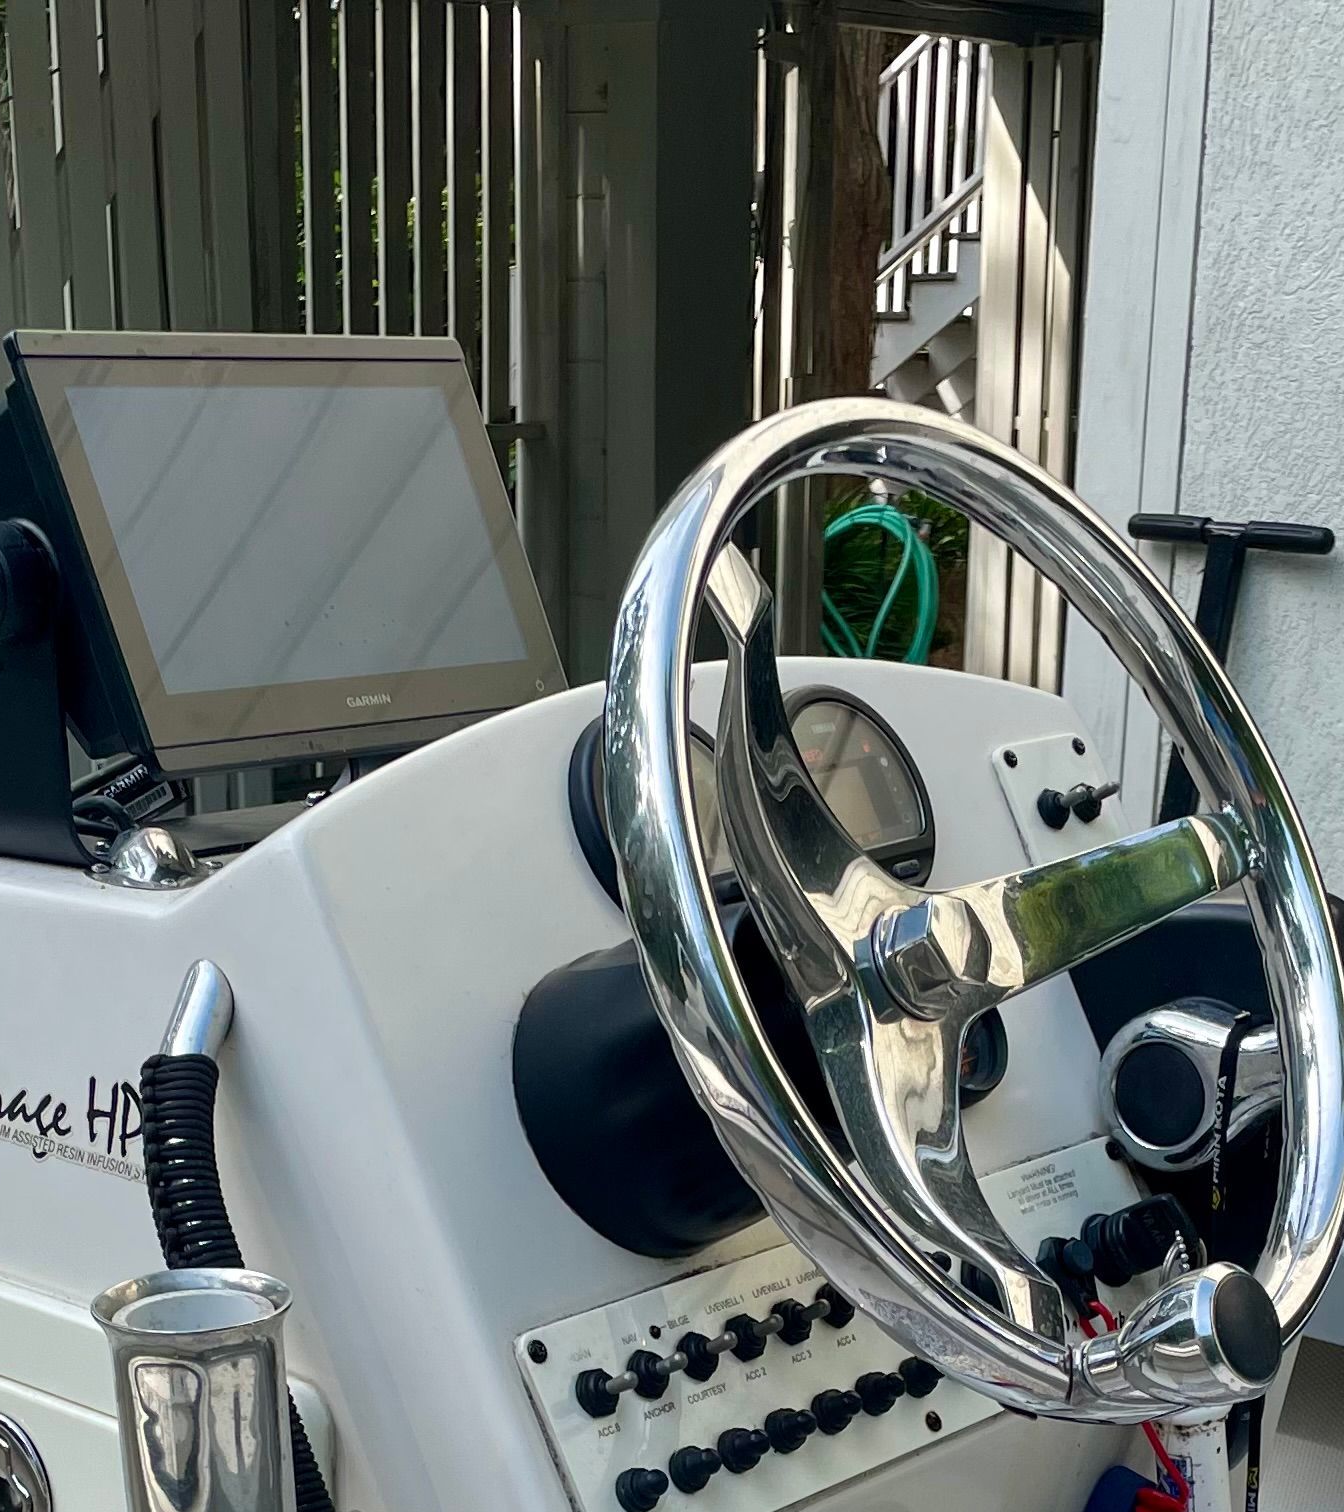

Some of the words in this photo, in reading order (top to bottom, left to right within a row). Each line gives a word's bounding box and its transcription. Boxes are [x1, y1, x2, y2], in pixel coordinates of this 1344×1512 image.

[346, 693, 392, 708] GARMIN
[103, 764, 150, 799] GARMIN
[11, 1128, 56, 1154] ASSISTED
[56, 1143, 85, 1163] RESIN
[87, 1151, 137, 1177] INFUSION
[751, 1282, 785, 1299] LIVEWELL
[704, 1296, 740, 1316] LIVEWELL
[666, 1314, 691, 1330] BILGE
[621, 1332, 638, 1346] NAV
[837, 1339, 851, 1349] ACC
[791, 1354, 806, 1364] ACC
[745, 1369, 760, 1382] ACC
[687, 1383, 728, 1405] COURTESY
[643, 1401, 677, 1422] ANCHOR
